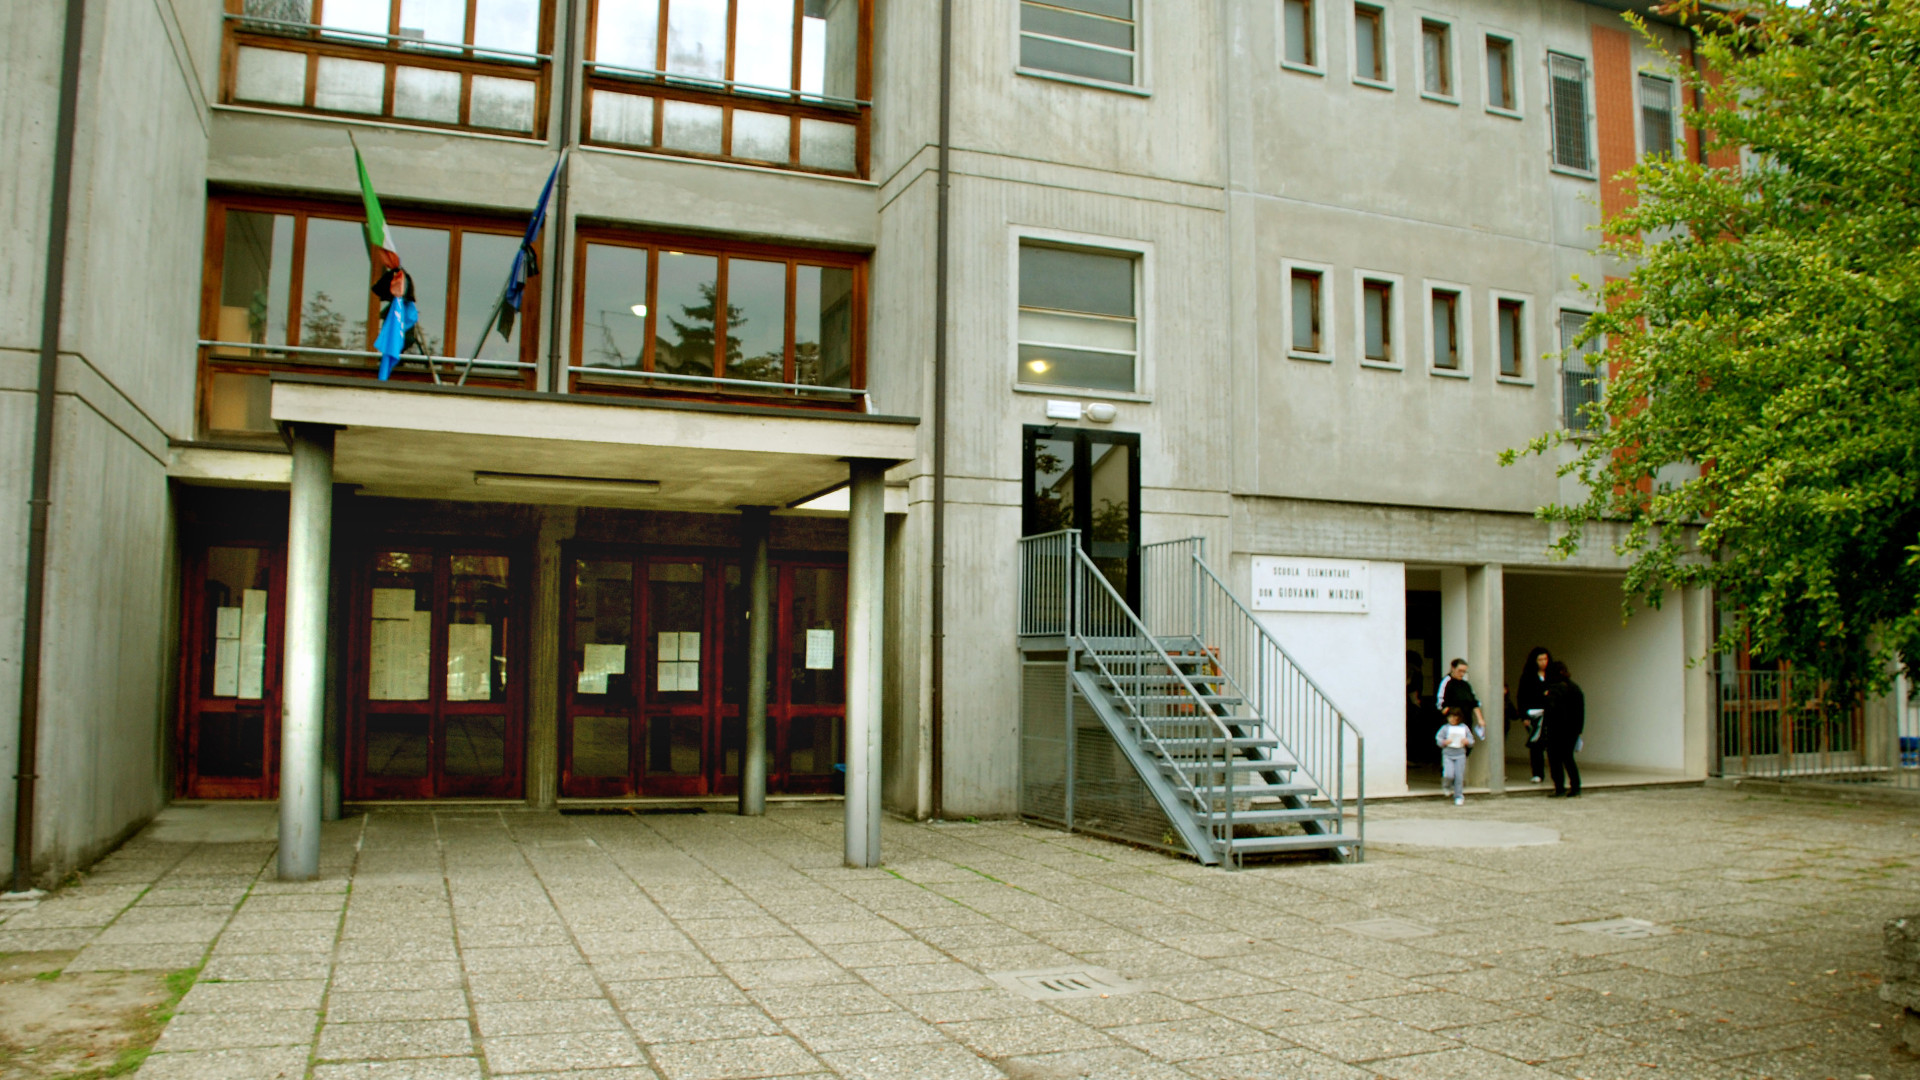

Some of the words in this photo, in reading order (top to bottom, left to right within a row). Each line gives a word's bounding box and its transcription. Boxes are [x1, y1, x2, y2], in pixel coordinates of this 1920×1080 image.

[1273, 567, 1299, 575] SCUOLA
[1307, 568, 1351, 578] ELEMENTARE
[1279, 587, 1319, 598] GIOVANNI
[1328, 589, 1364, 600] MINZONI
